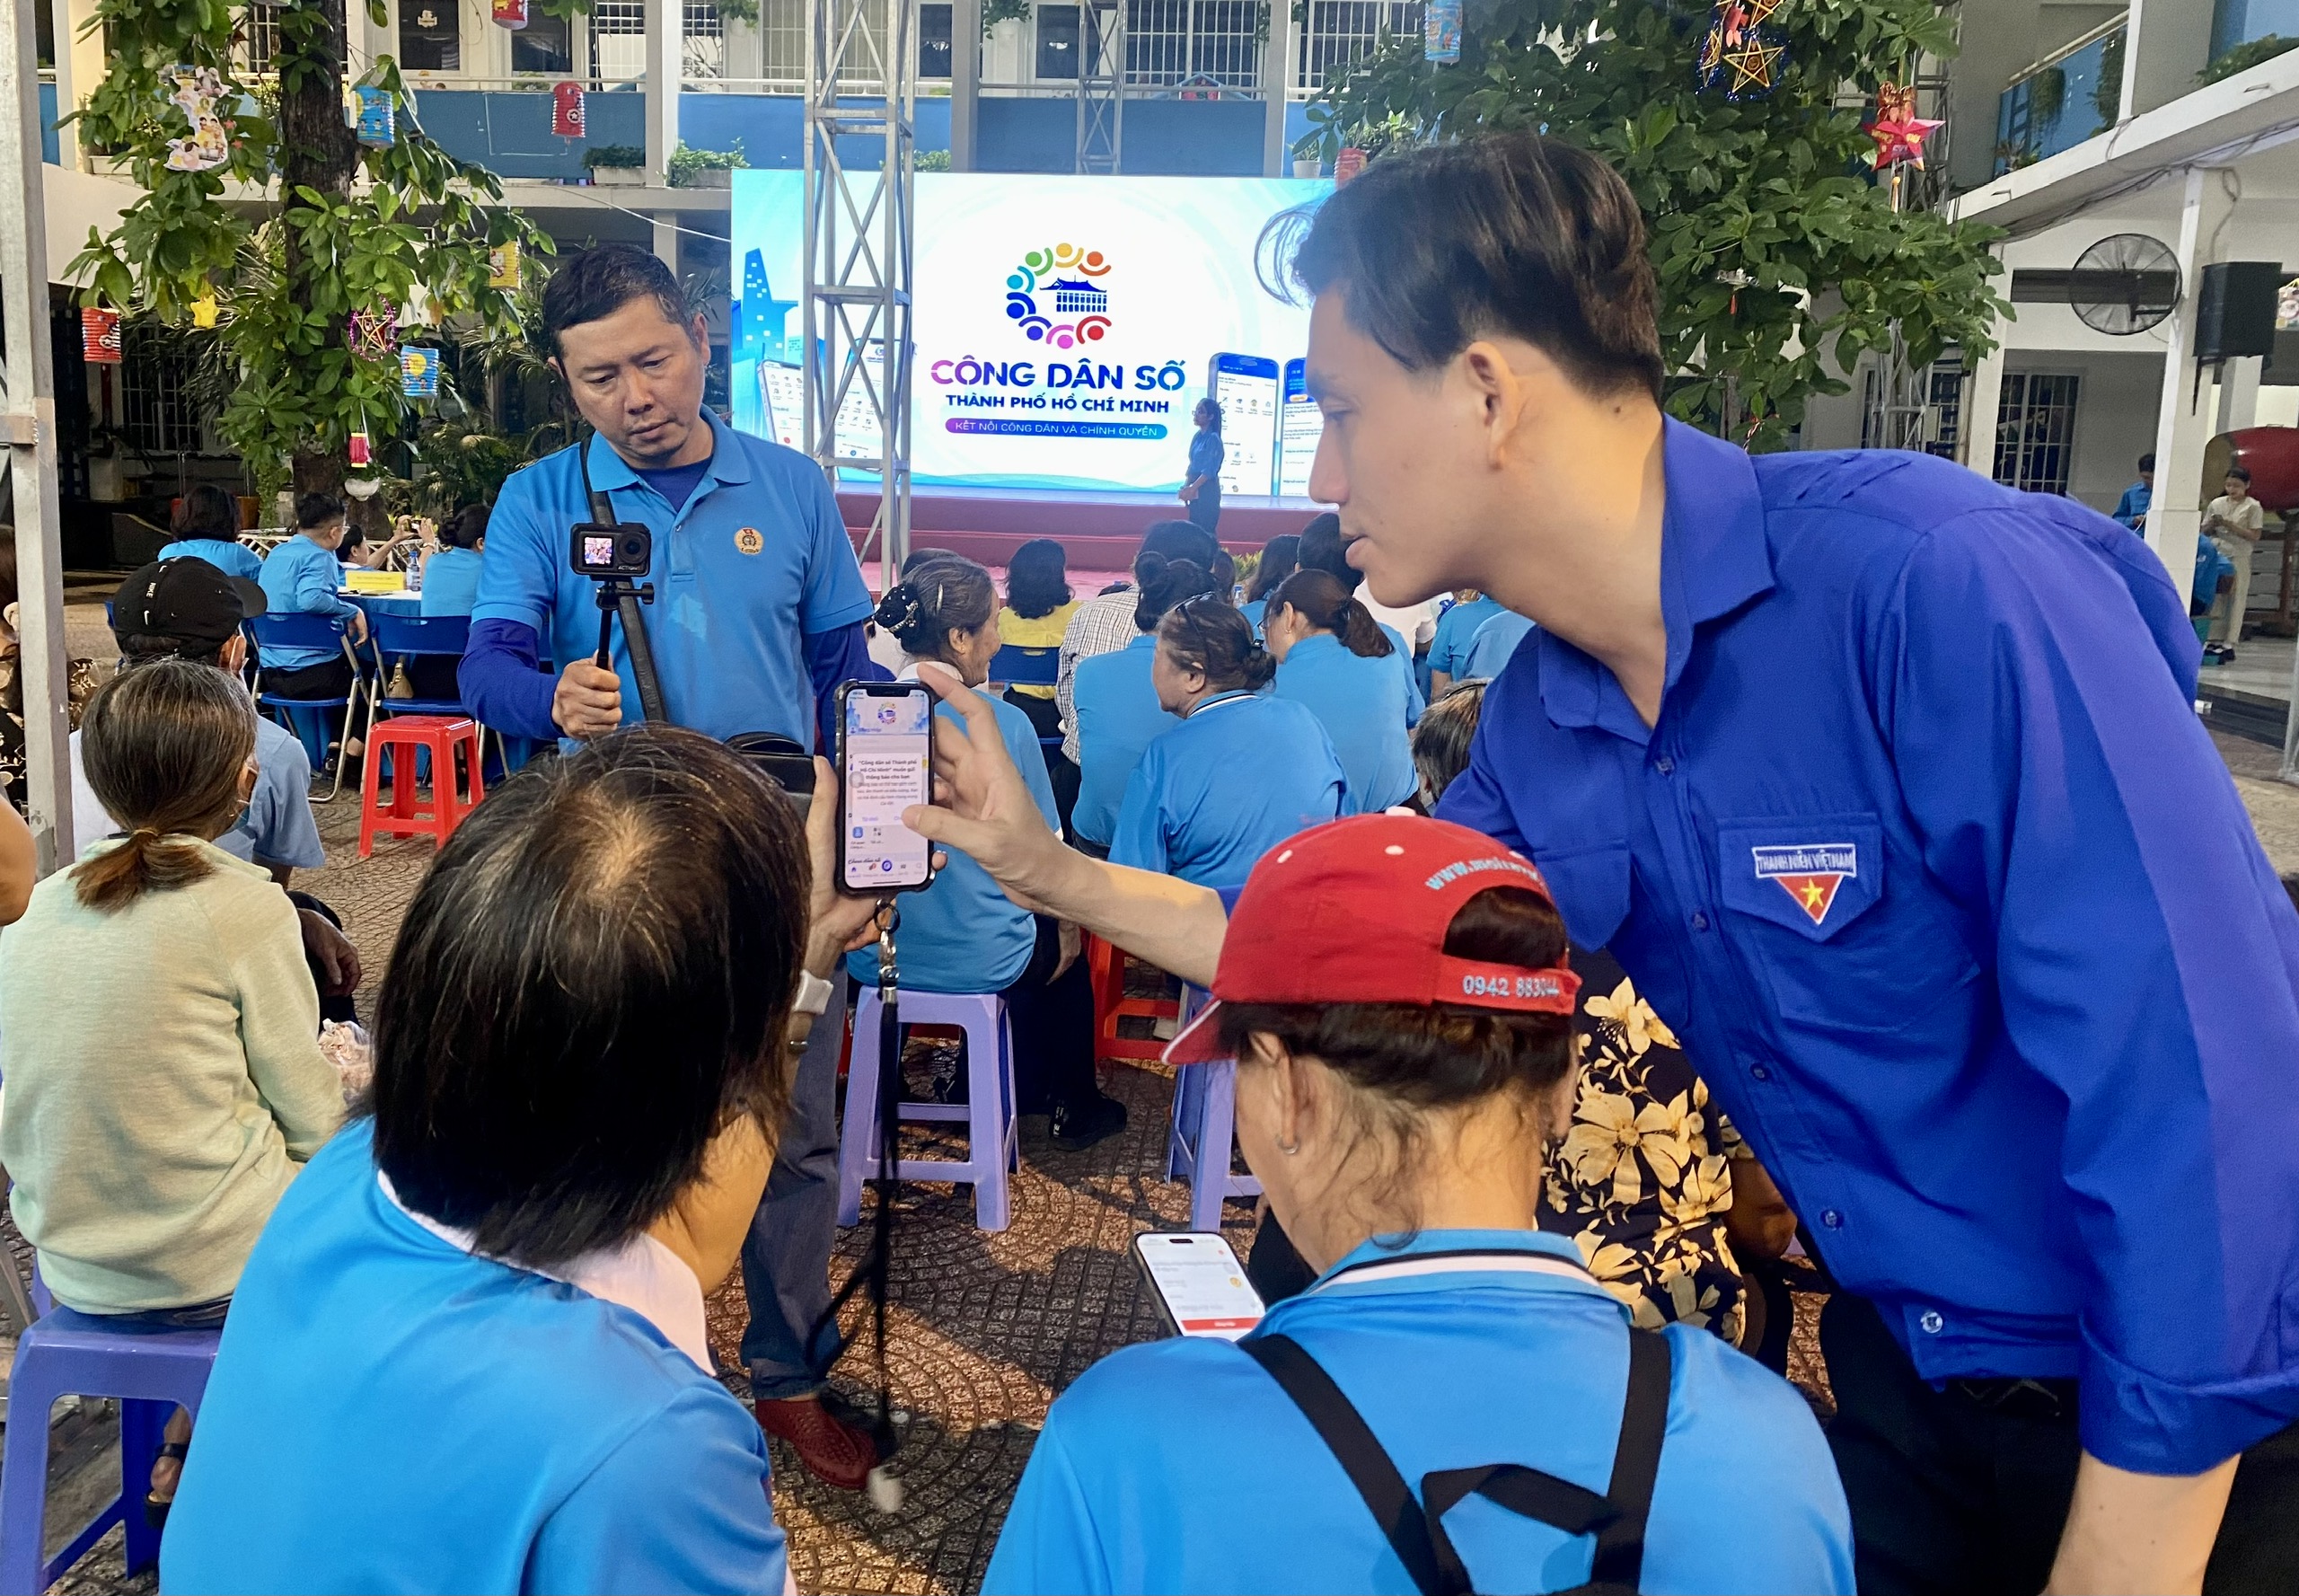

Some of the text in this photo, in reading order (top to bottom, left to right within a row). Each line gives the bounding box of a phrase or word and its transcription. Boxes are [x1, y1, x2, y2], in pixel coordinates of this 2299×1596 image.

[930, 355, 1185, 391] CÔNG DÂN SỐ
[946, 392, 1168, 413] THÀNH PHỐ HỒ CHÍ MINH
[1000, 422, 1032, 433] CÔNG
[1035, 423, 1059, 433] DÂN
[1061, 424, 1078, 434] VÀ
[1080, 425, 1115, 435] CHÍNH
[145, 582, 156, 599] NIKE
[1757, 855, 1789, 871] THANH
[1831, 852, 1854, 869] NAM
[1463, 974, 1510, 997] 0942
